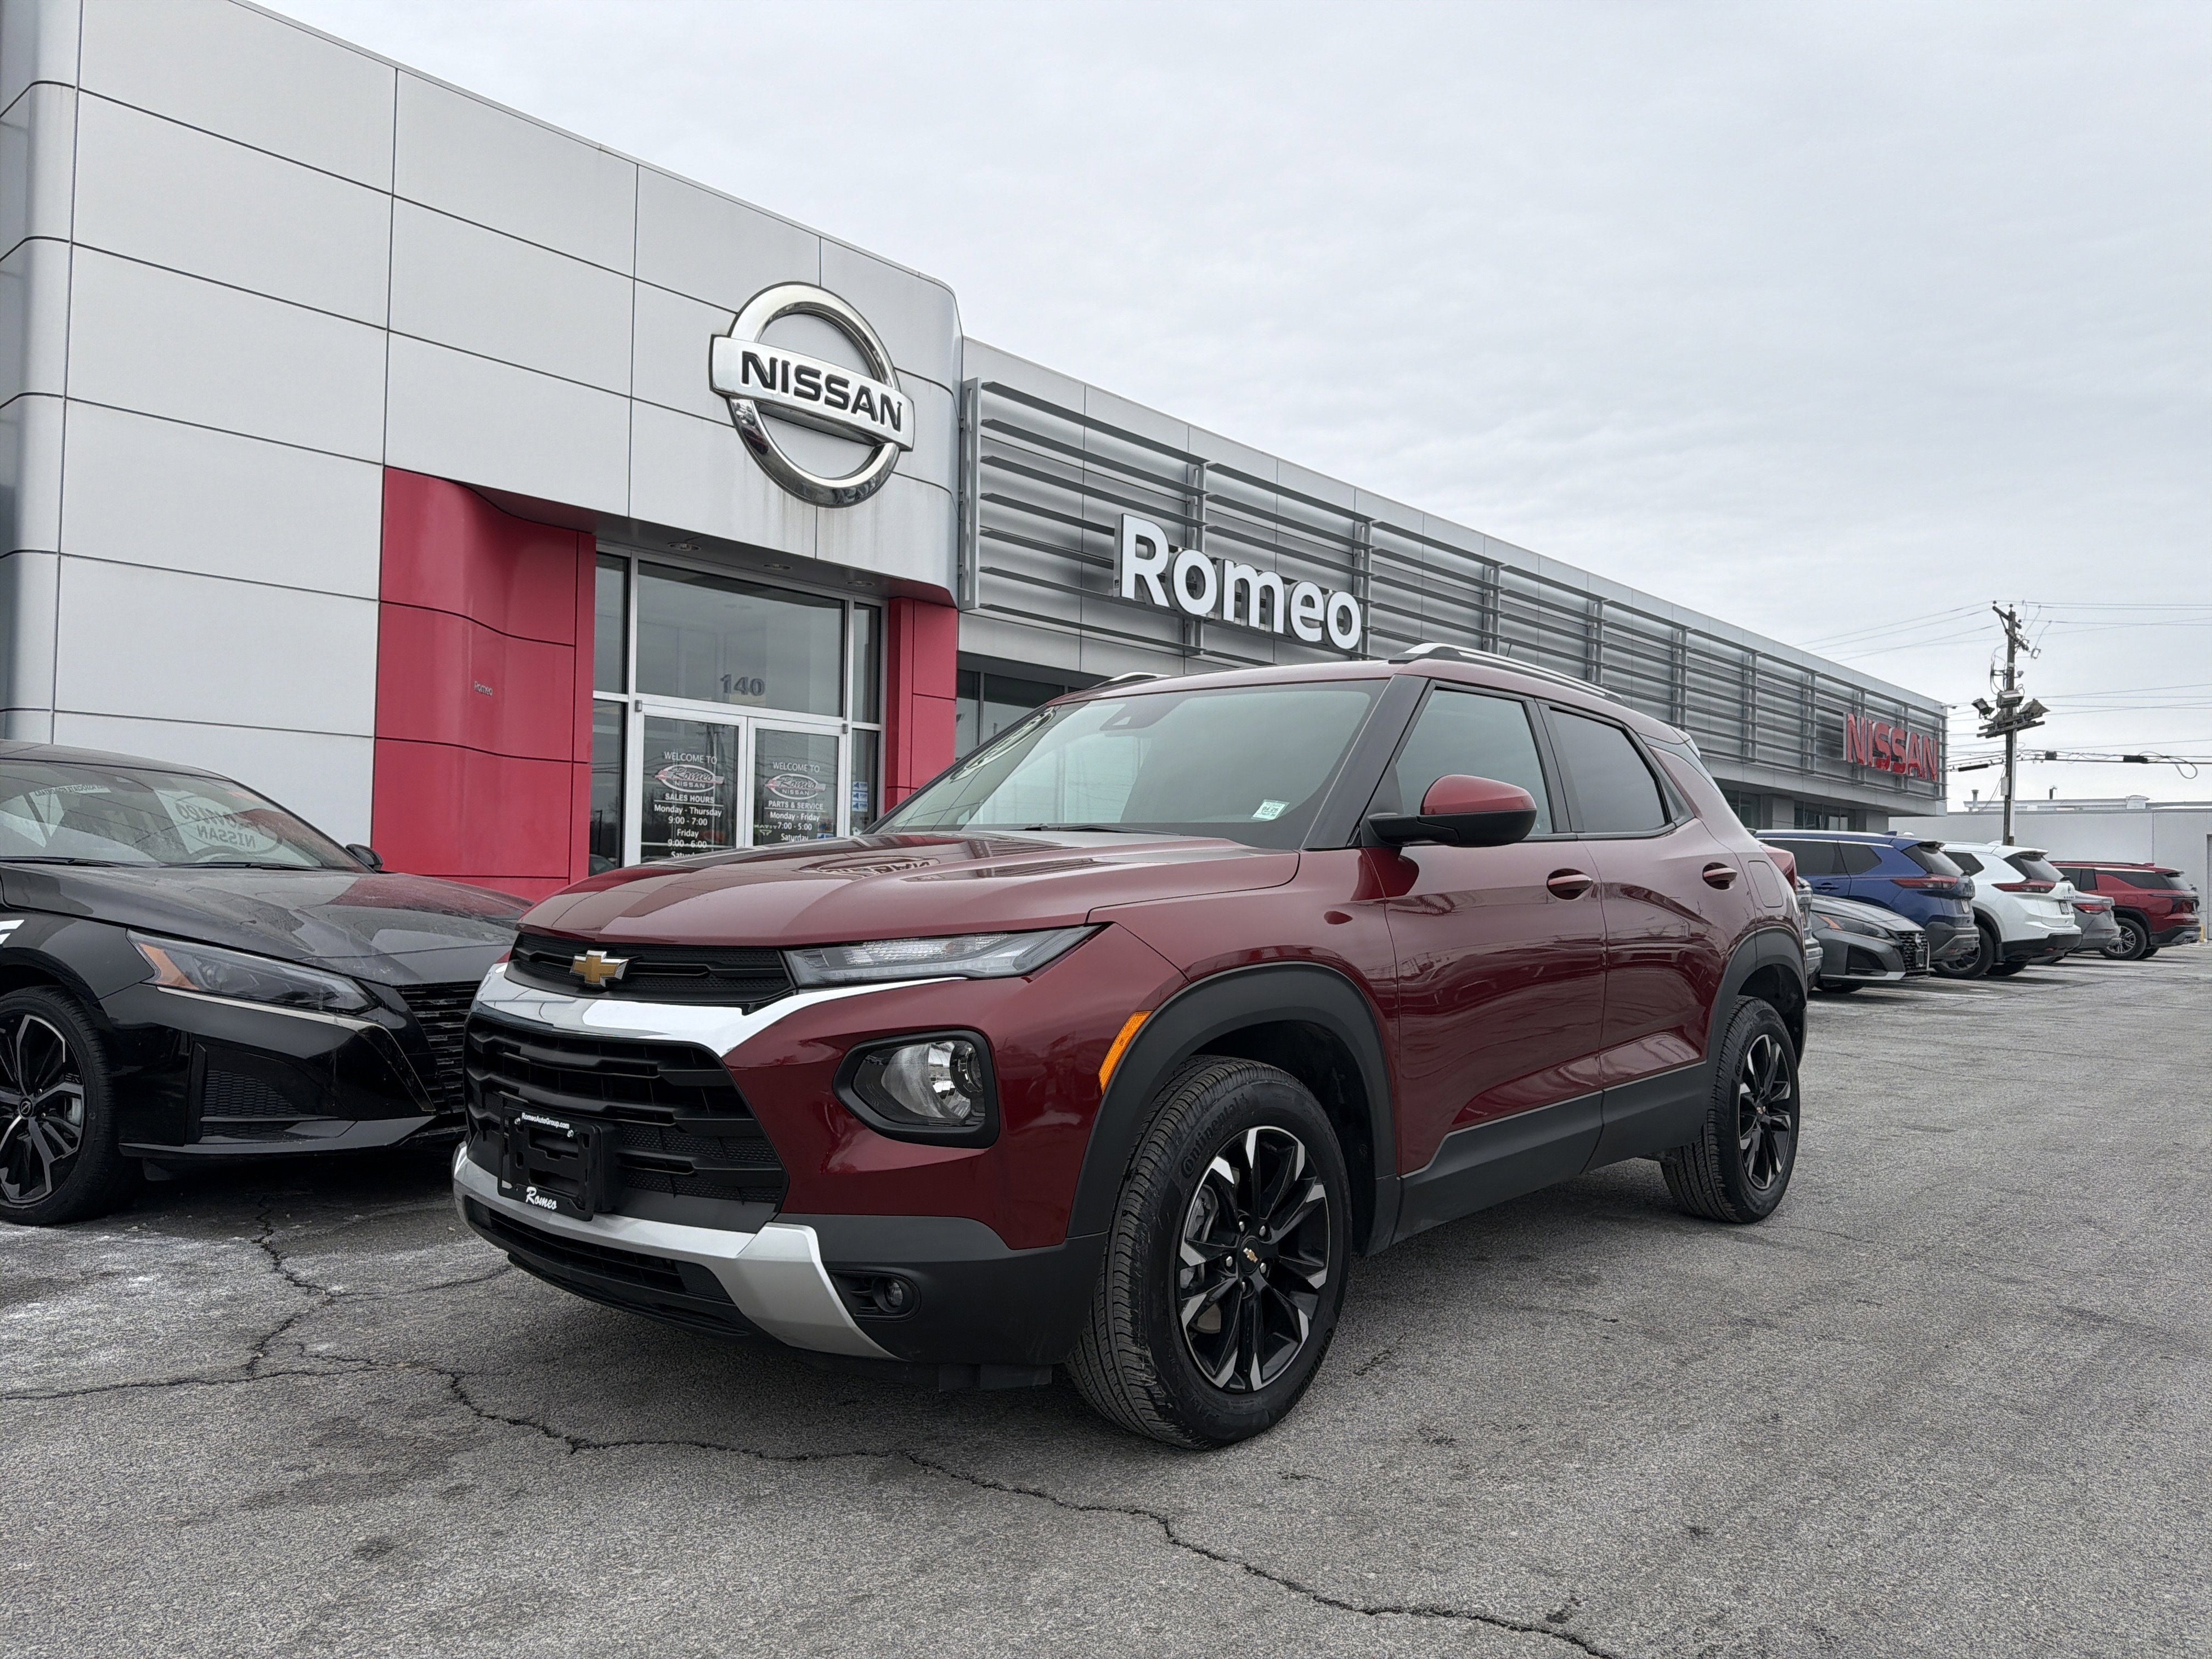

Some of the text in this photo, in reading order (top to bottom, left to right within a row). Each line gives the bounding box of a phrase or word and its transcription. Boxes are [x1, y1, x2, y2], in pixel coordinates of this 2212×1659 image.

[741, 351, 902, 432] NISSAN
[1119, 513, 1362, 650] Romeo
[474, 681, 493, 696] Romeo
[720, 674, 765, 696] 140
[1844, 713, 1938, 782] NISSAN
[664, 751, 718, 764] WELCOME TO
[668, 766, 713, 781] Romeo
[772, 761, 820, 773] WELCOME TO
[778, 775, 817, 789] Romeo
[665, 793, 715, 804] SALES HOURS
[768, 800, 789, 808] PARTS
[654, 804, 683, 814] Monday
[689, 806, 722, 817] Thursday
[770, 811, 795, 821] Monday
[800, 813, 820, 822] Friday
[668, 816, 685, 825] 9:00
[692, 817, 708, 826] 7:00
[798, 822, 812, 831] 5:00
[676, 828, 699, 838] Friday
[667, 839, 685, 847] 9:00
[691, 840, 707, 848] 6:00
[522, 1112, 570, 1130] RomeoAutoGroup.com
[1181, 1096, 1242, 1179] Continental
[525, 1186, 557, 1210] Romeo
